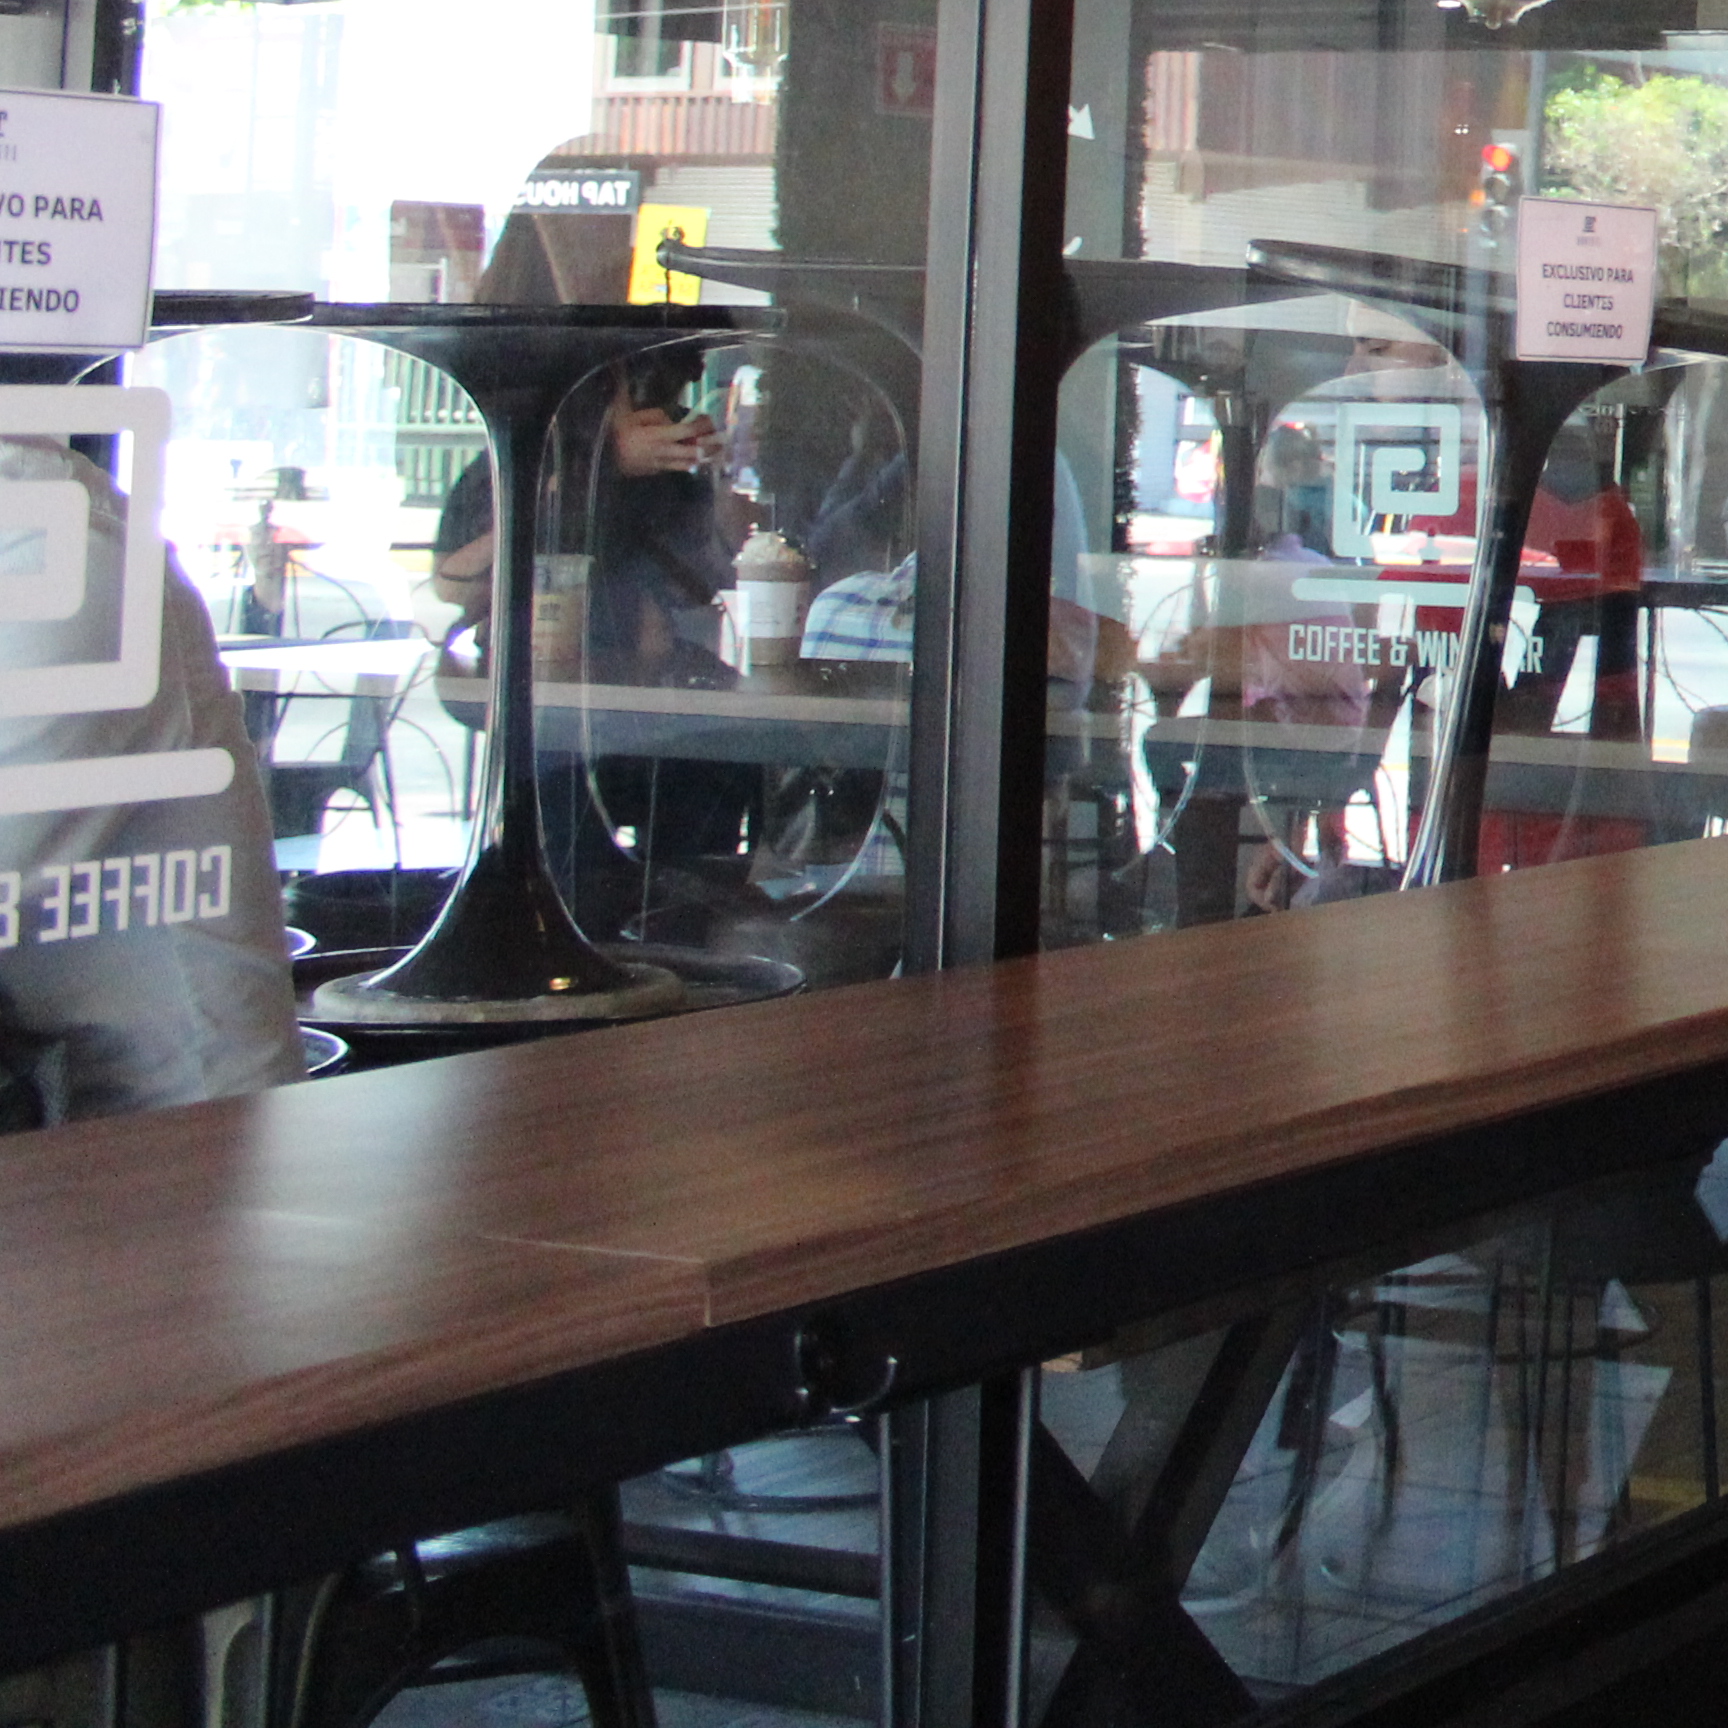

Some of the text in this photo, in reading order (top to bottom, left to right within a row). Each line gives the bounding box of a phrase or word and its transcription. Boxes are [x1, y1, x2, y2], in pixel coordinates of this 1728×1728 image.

[34, 195, 103, 221] PARA
[1542, 264, 1634, 283] EXCLUSIVO PARA
[1563, 294, 1614, 311] CLIENTES
[1547, 321, 1624, 339] CONSUMIENDO
[1288, 624, 1382, 666] COFFEE
